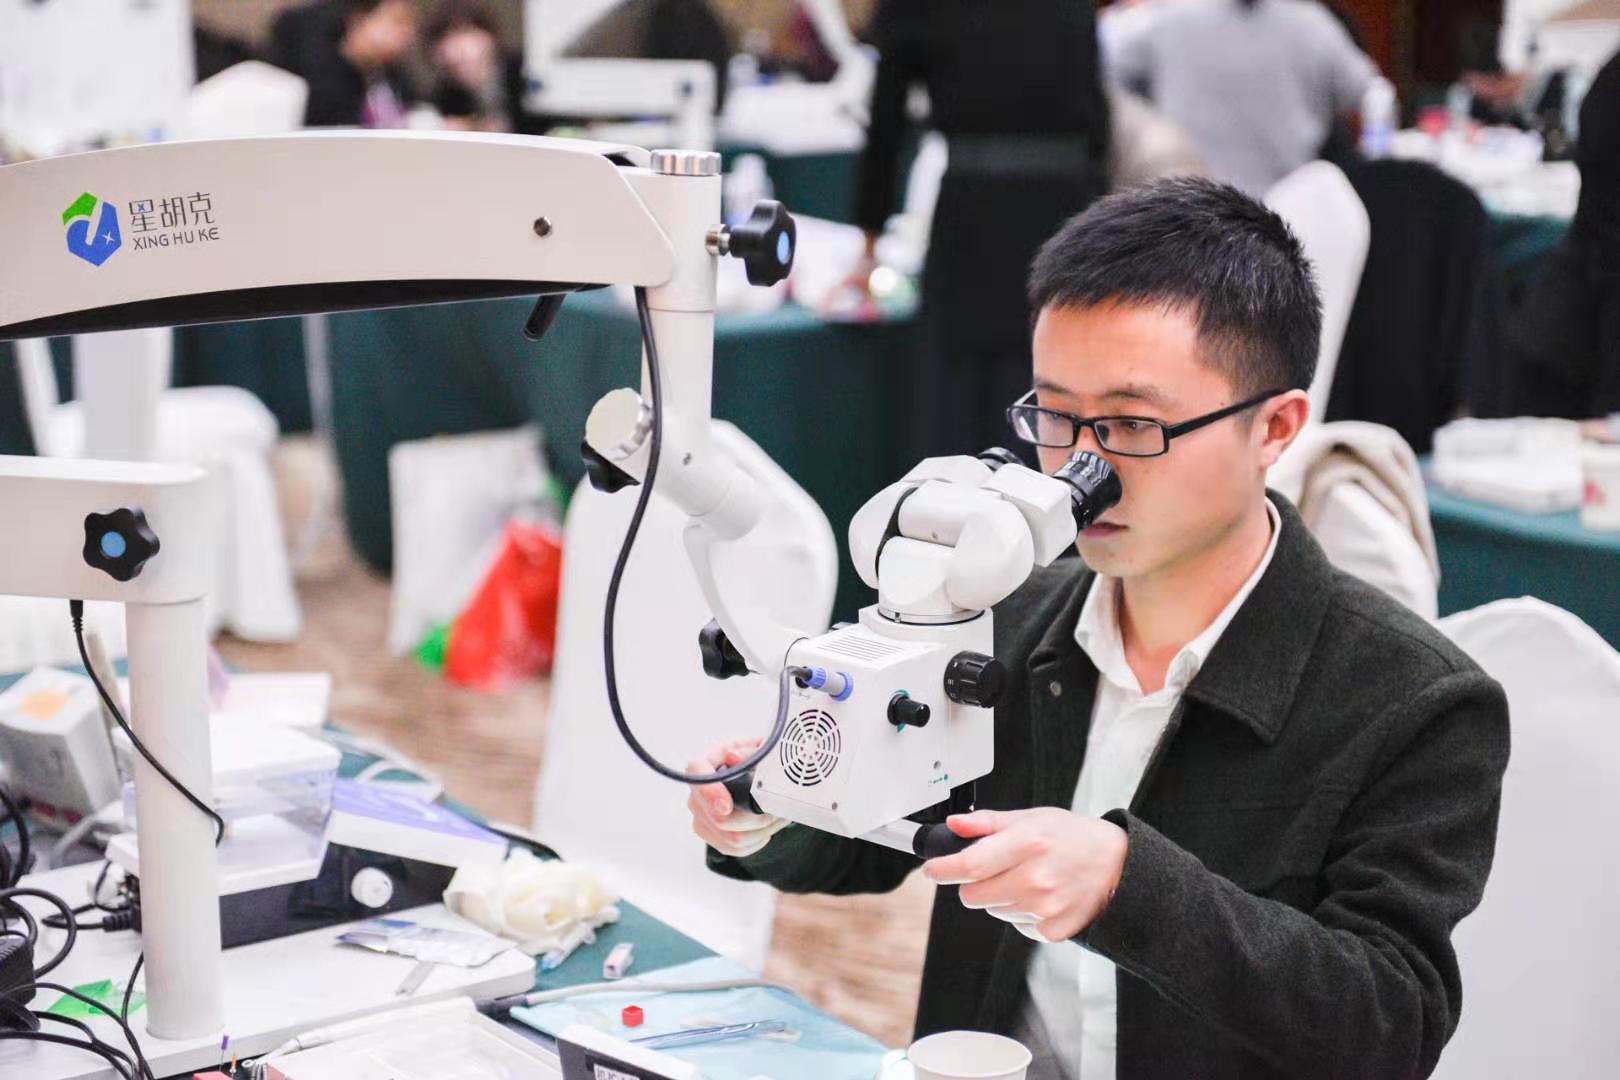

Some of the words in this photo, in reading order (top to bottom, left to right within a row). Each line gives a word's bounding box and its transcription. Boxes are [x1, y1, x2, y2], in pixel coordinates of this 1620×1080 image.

[129, 192, 215, 233] 星胡克
[133, 234, 169, 250] XING
[173, 231, 194, 244] HU
[199, 227, 220, 242] KE
